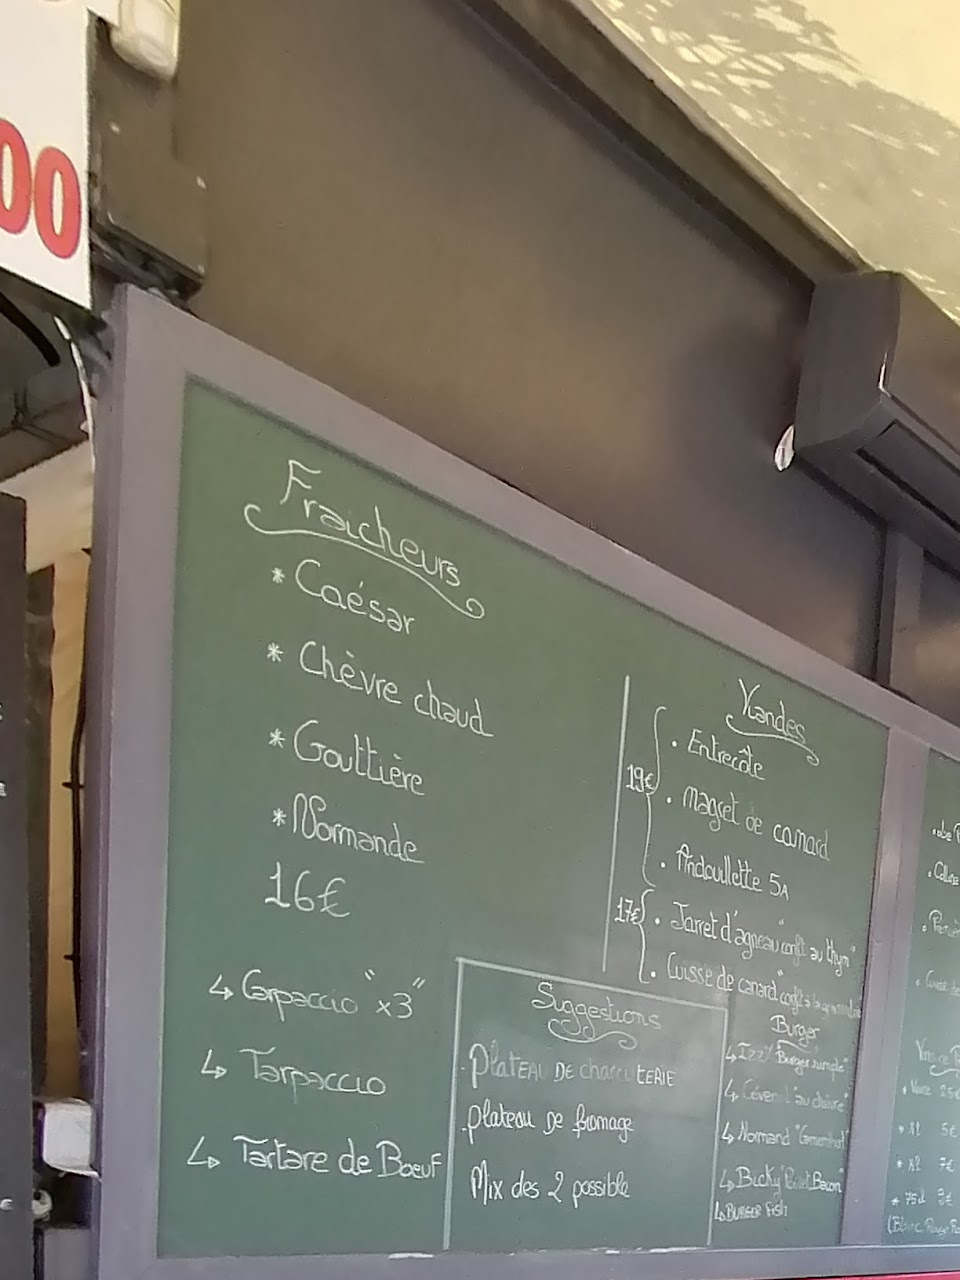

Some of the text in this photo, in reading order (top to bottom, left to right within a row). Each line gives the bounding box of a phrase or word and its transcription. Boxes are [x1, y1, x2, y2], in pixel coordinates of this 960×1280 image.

[295, 558, 415, 634] Caésar
[299, 640, 494, 737] Chèvre chaud
[294, 720, 425, 795] Gouttière
[626, 764, 655, 792] 19€
[687, 729, 765, 780] Entrecôte
[293, 792, 425, 864] Normande
[773, 823, 831, 862] canard
[264, 862, 350, 918] 16€
[676, 843, 762, 892] Andouillette
[614, 897, 641, 924] 17€
[670, 901, 718, 940] Jarret
[241, 968, 359, 1022] Carpaccio
[666, 952, 713, 987] Cuisse
[716, 964, 735, 991] de
[738, 978, 779, 1001] canard
[531, 981, 662, 1040] Suggestions
[770, 1014, 820, 1048] Burger
[238, 1045, 387, 1105] Tarpaccio
[233, 1135, 330, 1173] Tartare
[338, 1137, 373, 1176] de
[737, 1120, 790, 1146] Normand
[471, 1160, 630, 1209] Mix des 2 possible
